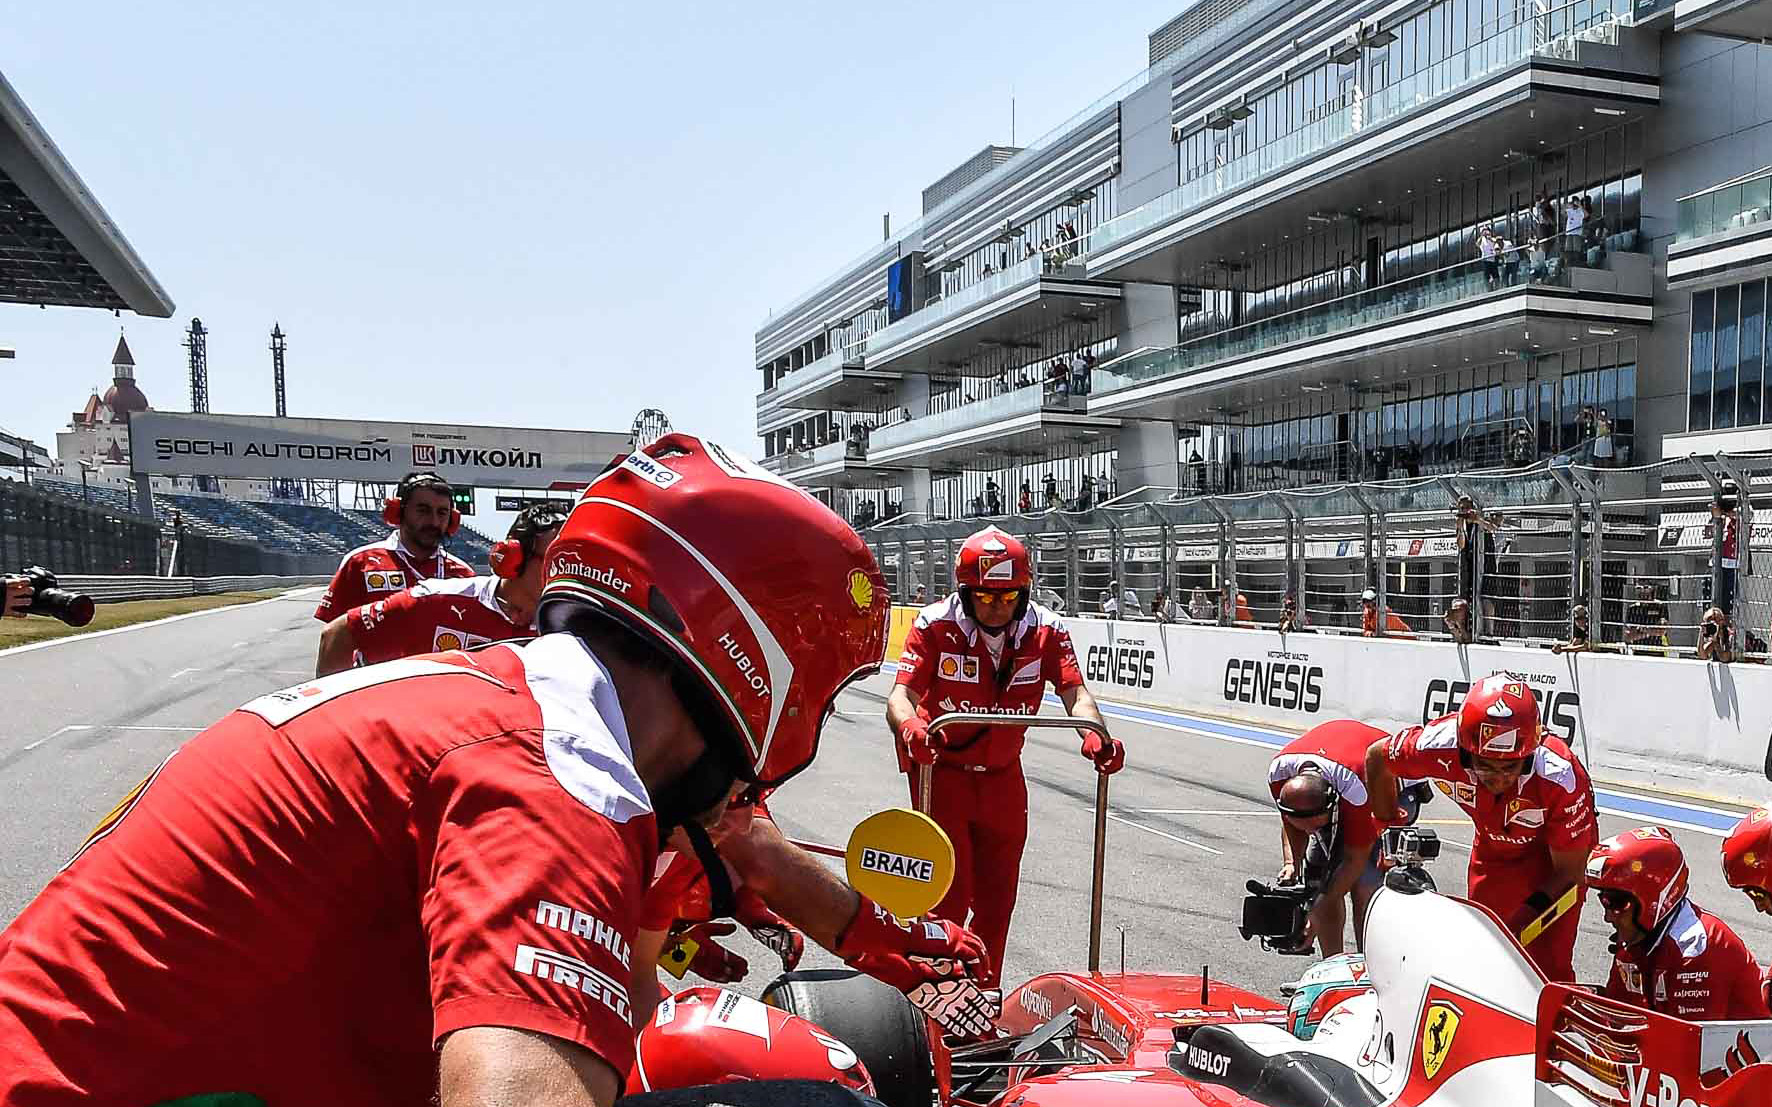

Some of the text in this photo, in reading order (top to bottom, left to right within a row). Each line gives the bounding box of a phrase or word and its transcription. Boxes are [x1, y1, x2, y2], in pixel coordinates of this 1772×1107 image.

[155, 439, 392, 462] SOCHI AUTODROM
[438, 447, 542, 469] ЛУКОЙЛ
[558, 557, 632, 594] Santander
[718, 632, 772, 698] HUBLOT
[1086, 645, 1155, 689] GENESIS
[1529, 673, 1557, 685] МАСЛО
[1223, 658, 1324, 713] GENESIS
[863, 850, 932, 881] BRAKE
[536, 900, 632, 972] MAHLE
[513, 944, 634, 1029] PIRELLI
[1187, 1046, 1232, 1078] HUBLOT
